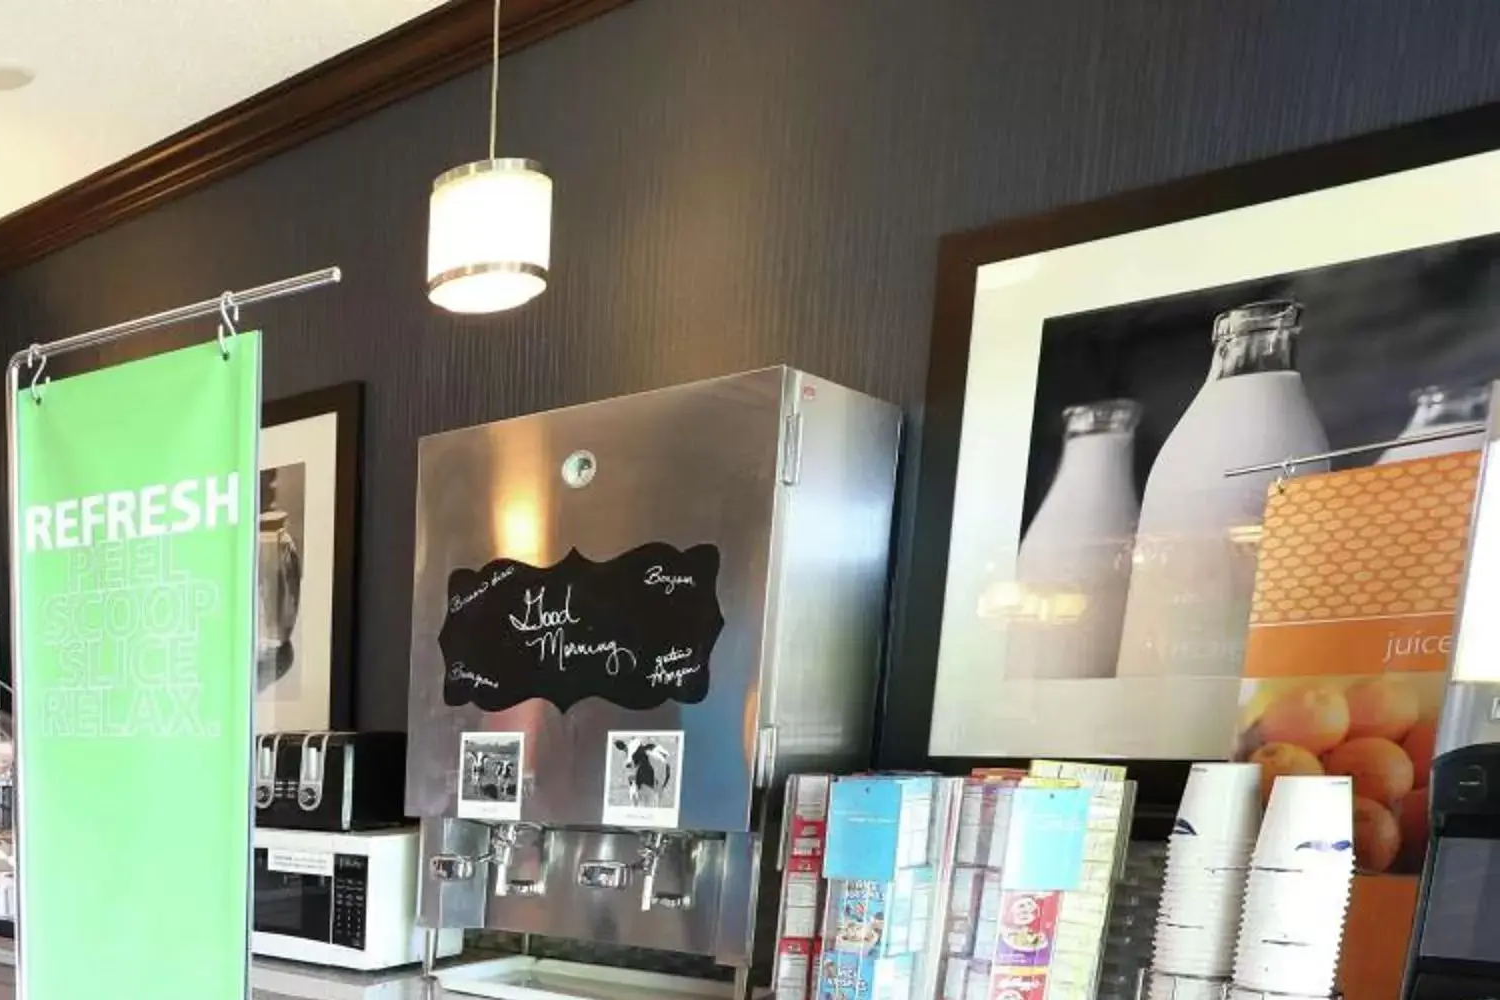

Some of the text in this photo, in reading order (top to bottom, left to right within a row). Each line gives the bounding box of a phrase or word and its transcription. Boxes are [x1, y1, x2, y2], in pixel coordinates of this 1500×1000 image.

[25, 471, 240, 552] REFRESH
[67, 534, 191, 596] PEEL
[42, 578, 221, 646] SCOOP
[508, 584, 581, 632] Good
[58, 633, 202, 692] SLICE
[524, 627, 637, 675] Morning
[1381, 629, 1453, 664] juice
